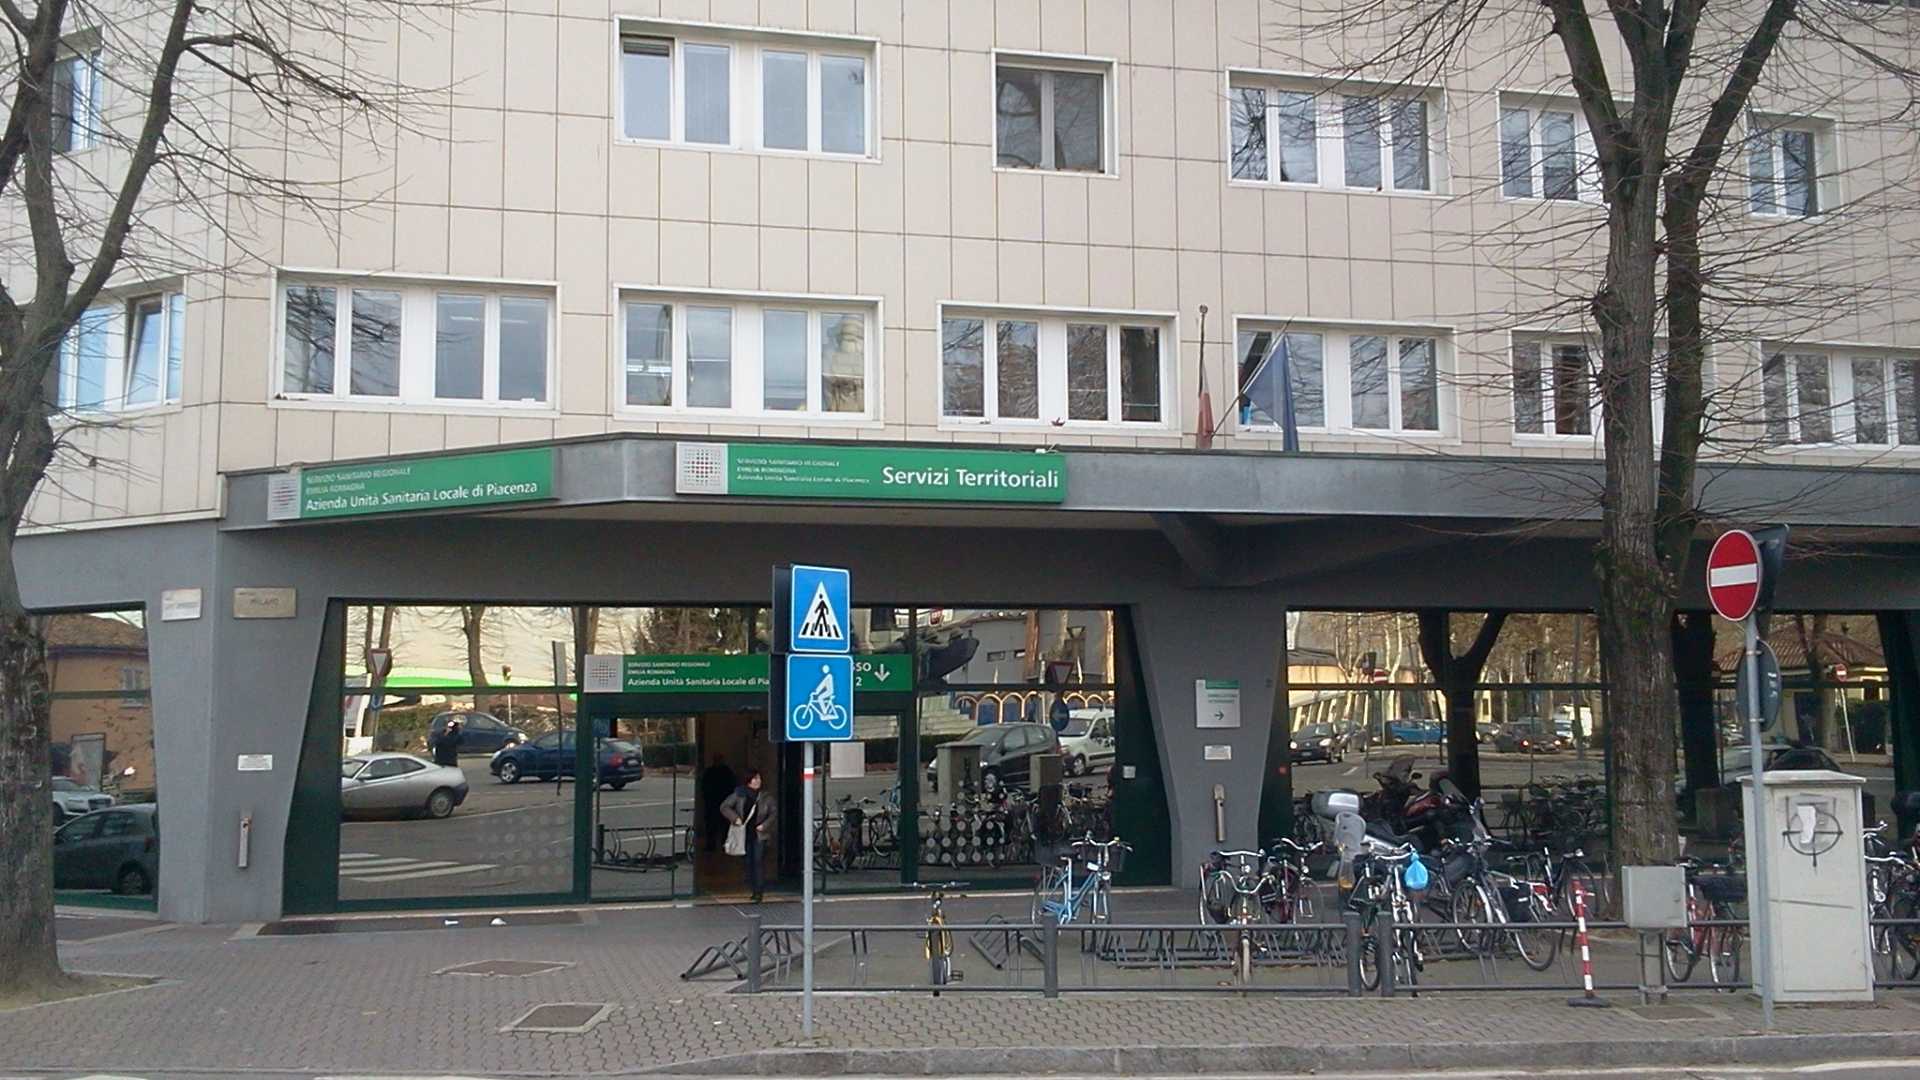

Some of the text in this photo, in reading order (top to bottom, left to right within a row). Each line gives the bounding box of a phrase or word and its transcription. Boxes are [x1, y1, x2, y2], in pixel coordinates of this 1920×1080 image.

[882, 466, 1059, 488] Servizi Territoriali
[306, 482, 538, 511] Azienda Unità Sanitaria Locale di Piacenza
[854, 662, 872, 672] SO
[627, 677, 770, 686] Azienda Unità Sanitaria Locale di Pia
